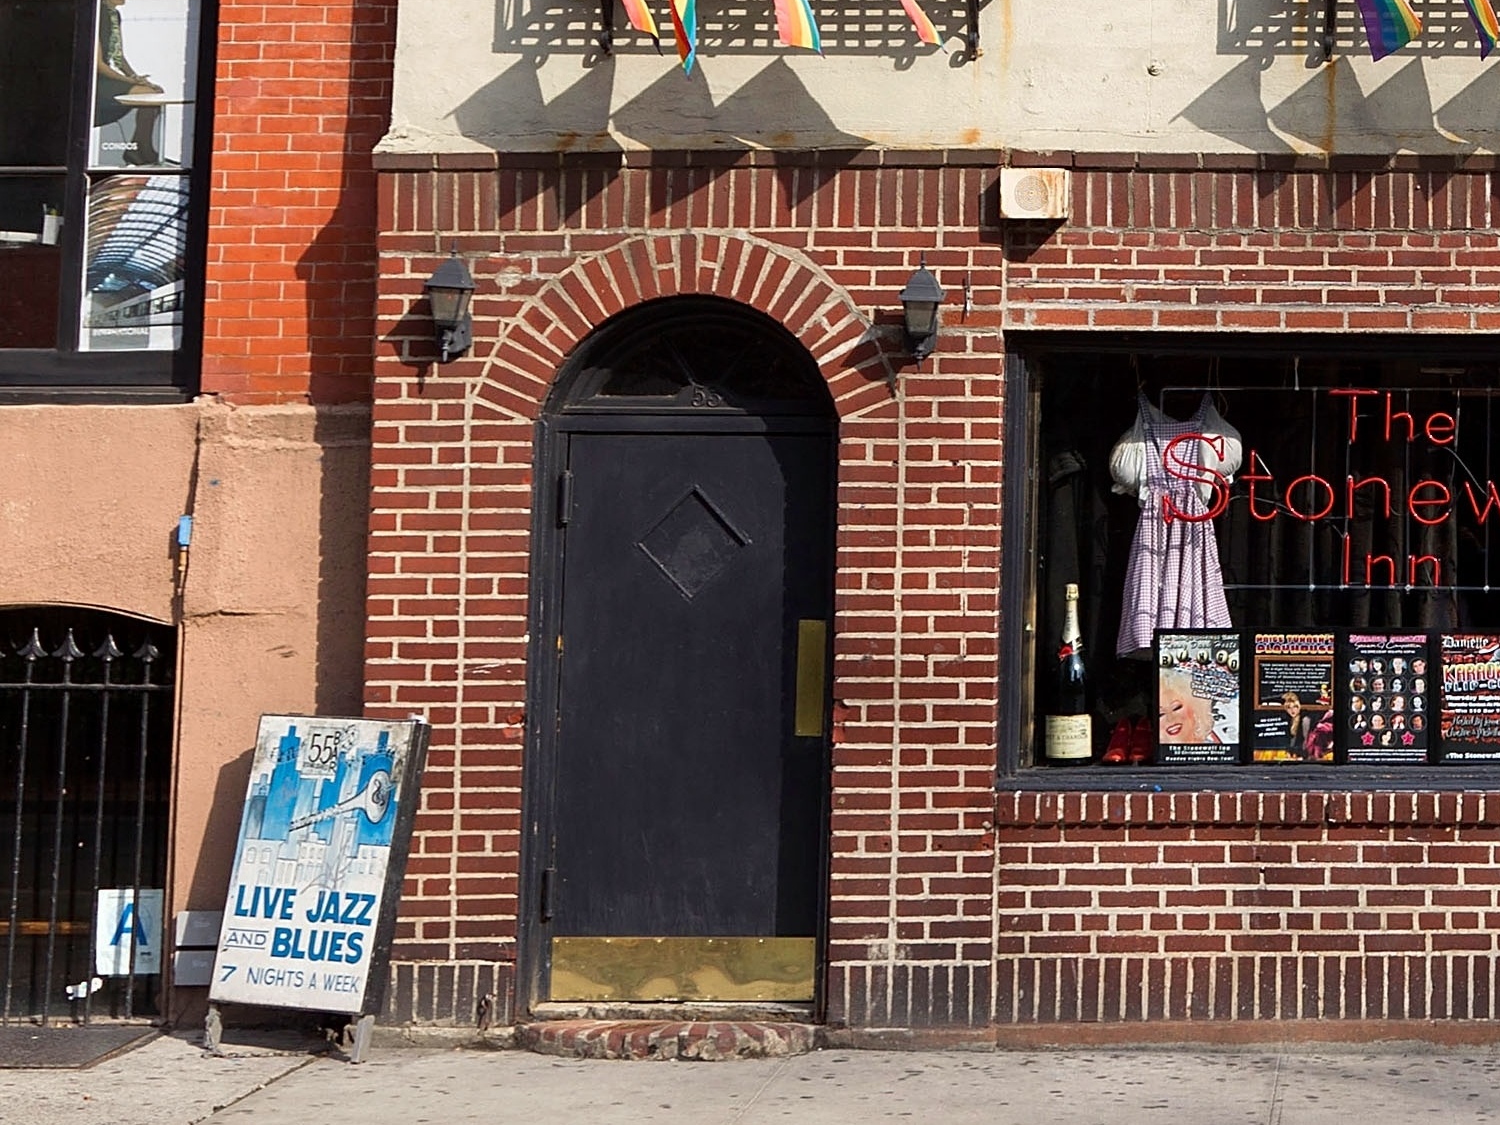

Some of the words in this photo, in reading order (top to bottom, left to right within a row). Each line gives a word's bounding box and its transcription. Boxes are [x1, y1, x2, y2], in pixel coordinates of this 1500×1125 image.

[102, 142, 138, 150] CONDOS
[1329, 389, 1456, 444] The
[1342, 533, 1441, 587] Inn
[308, 733, 334, 764] 55
[109, 903, 148, 946] A
[234, 885, 297, 920] LIVE
[306, 890, 377, 926] JAZZ
[227, 931, 267, 946] AND
[270, 927, 364, 964] BLUES
[220, 965, 237, 982] 7
[246, 967, 304, 988] NIGHTS
[308, 972, 317, 990] A
[323, 974, 360, 993] WEEK
